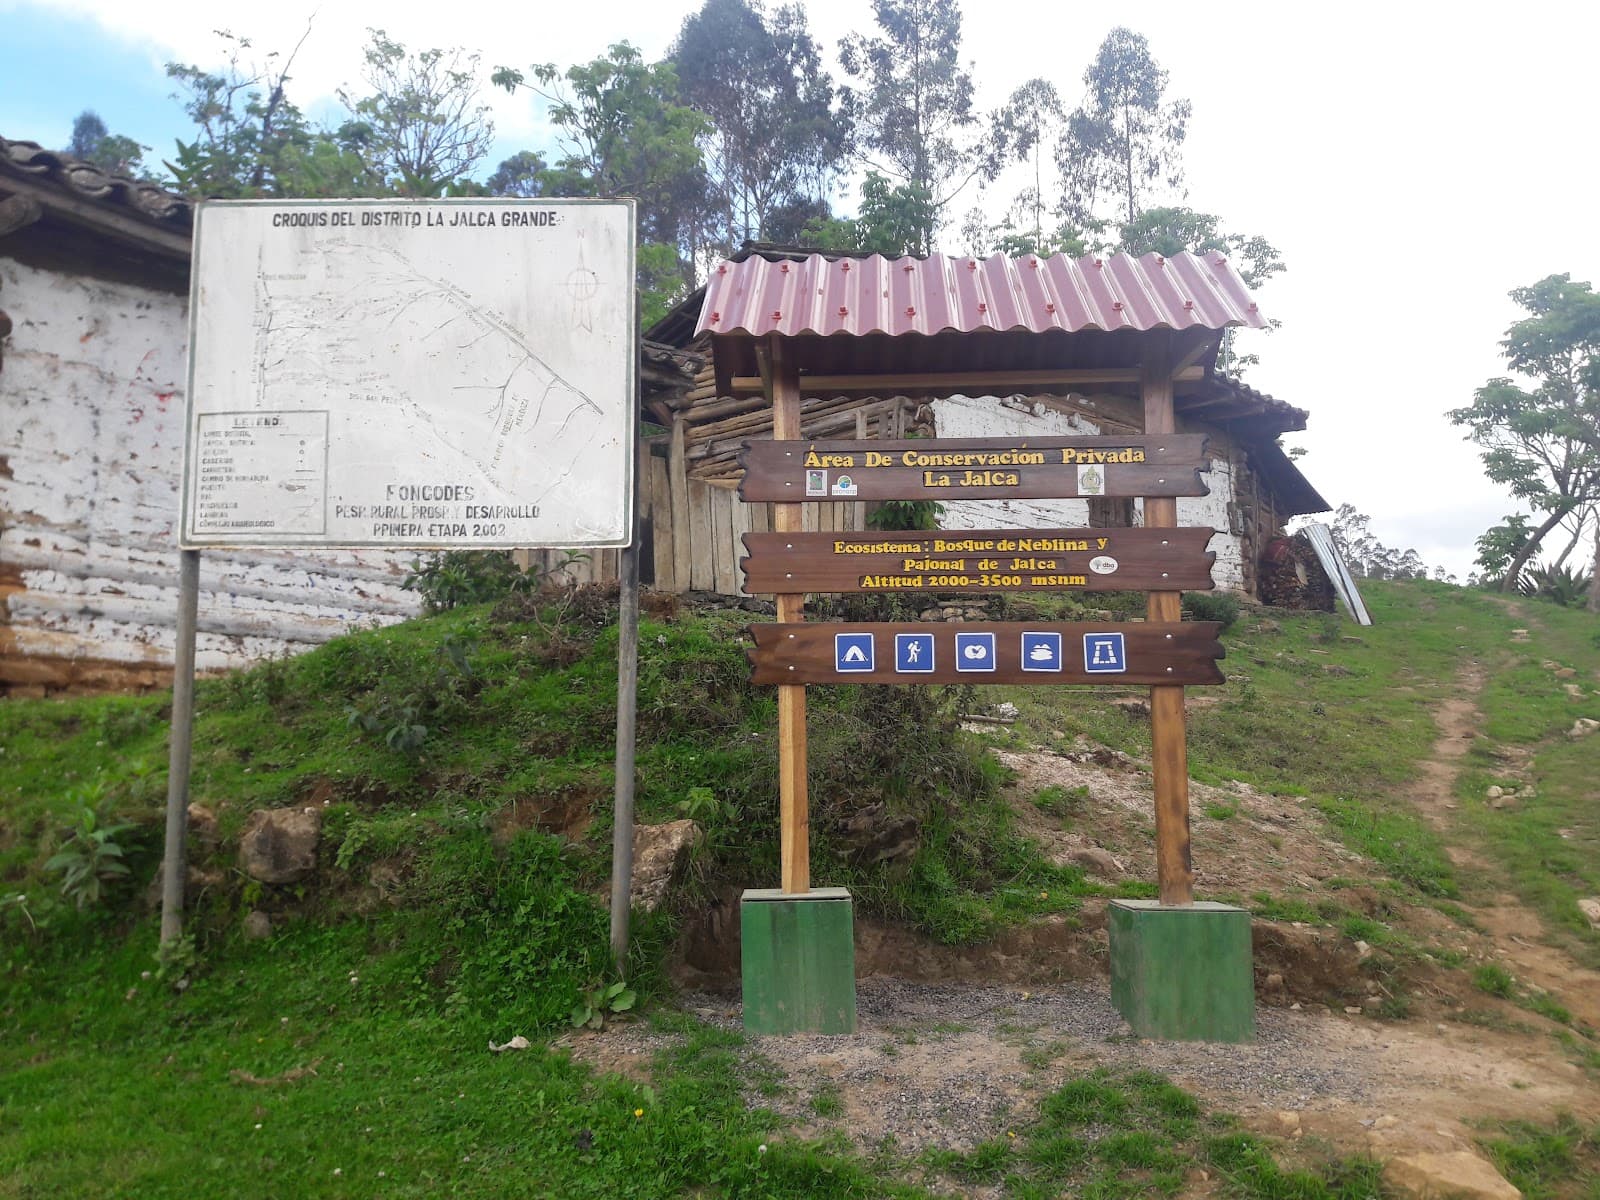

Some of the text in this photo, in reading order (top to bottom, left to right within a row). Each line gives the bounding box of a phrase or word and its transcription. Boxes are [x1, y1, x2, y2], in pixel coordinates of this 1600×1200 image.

[273, 211, 557, 228] CROQUIS DEL DISTRITO LA JALCA GRANDE
[804, 443, 1146, 468] Área De Conservación Privada
[924, 471, 950, 487] La
[429, 523, 467, 537] ETAPA
[934, 539, 994, 552] Bosque
[996, 539, 1016, 552] de
[1017, 539, 1089, 552] Neblina
[903, 555, 1057, 571] Pajonal de Jalca
[861, 574, 1086, 588] Altitud 2000-3500 msnm
